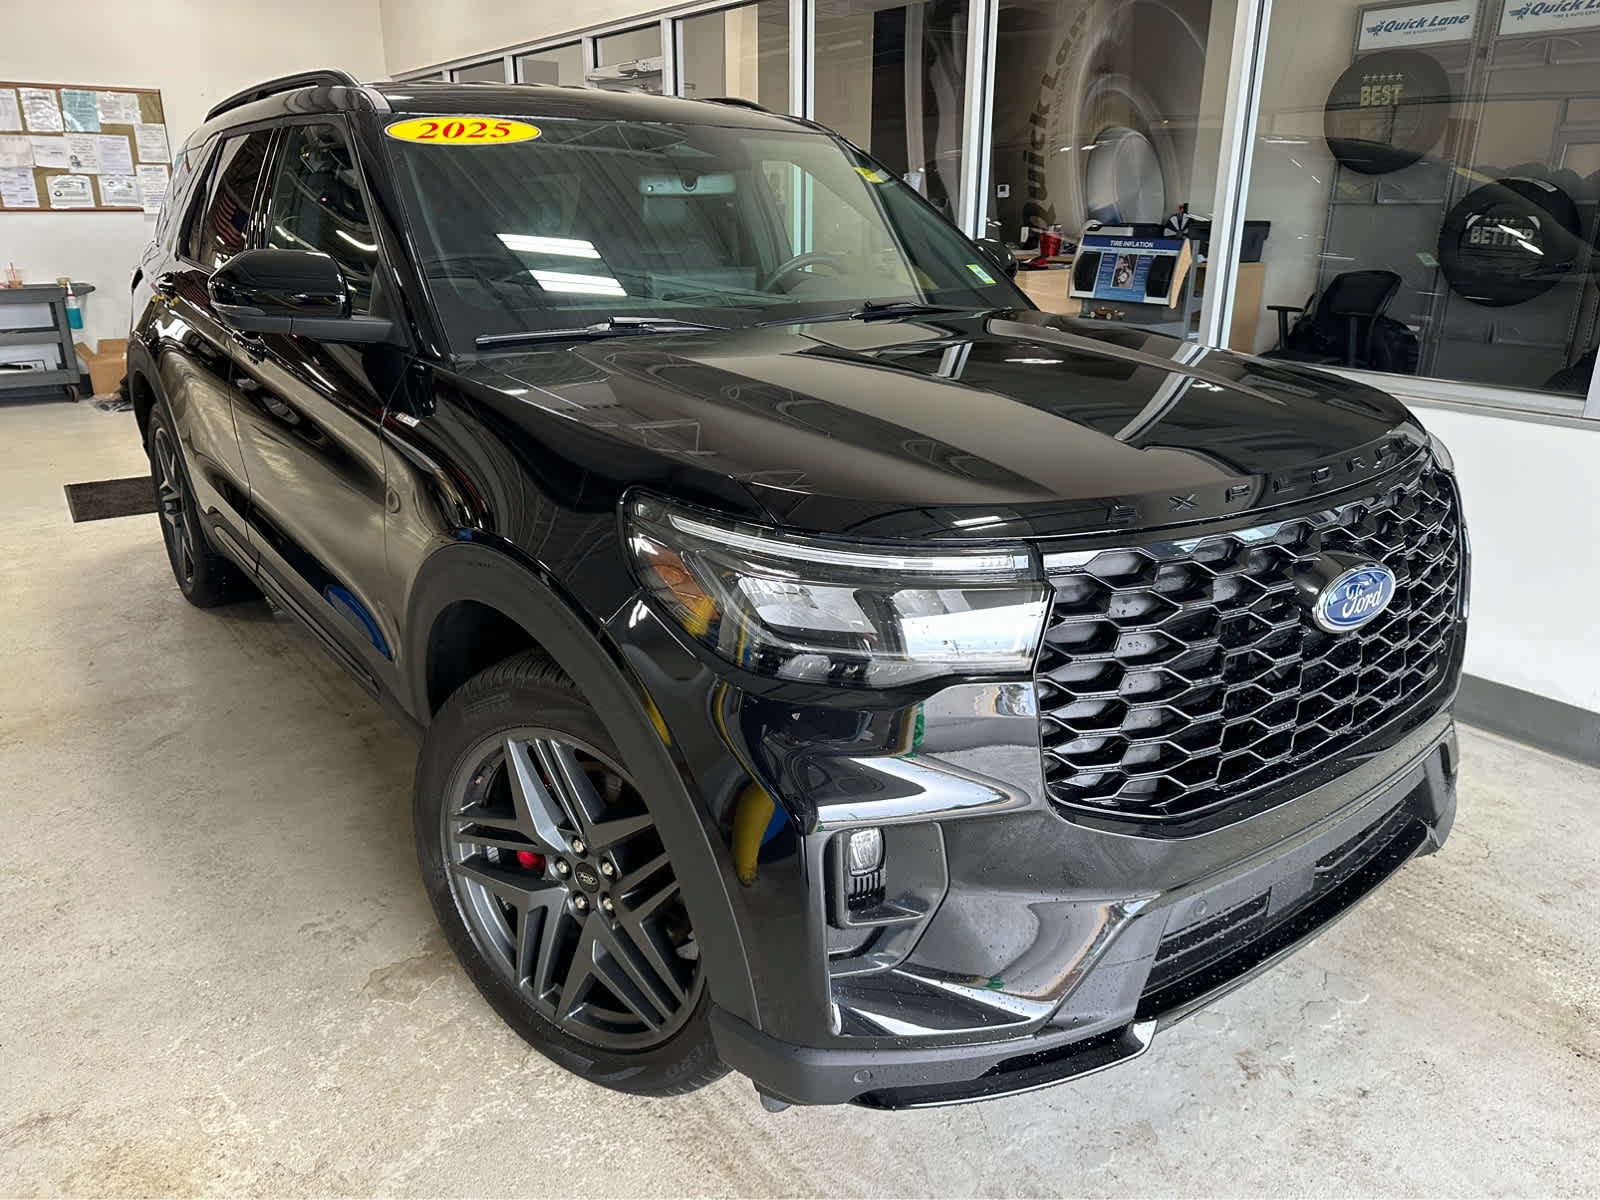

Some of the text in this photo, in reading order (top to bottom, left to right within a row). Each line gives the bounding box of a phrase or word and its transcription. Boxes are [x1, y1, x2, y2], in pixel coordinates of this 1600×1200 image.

[1529, 0, 1582, 16] Quick
[1383, 15, 1471, 32] Quick Lane
[1360, 84, 1404, 106] BEST
[416, 121, 513, 139] 2025
[1022, 103, 1057, 230] Quick
[1123, 240, 1154, 248] INFLATION
[1342, 578, 1384, 618] Ford
